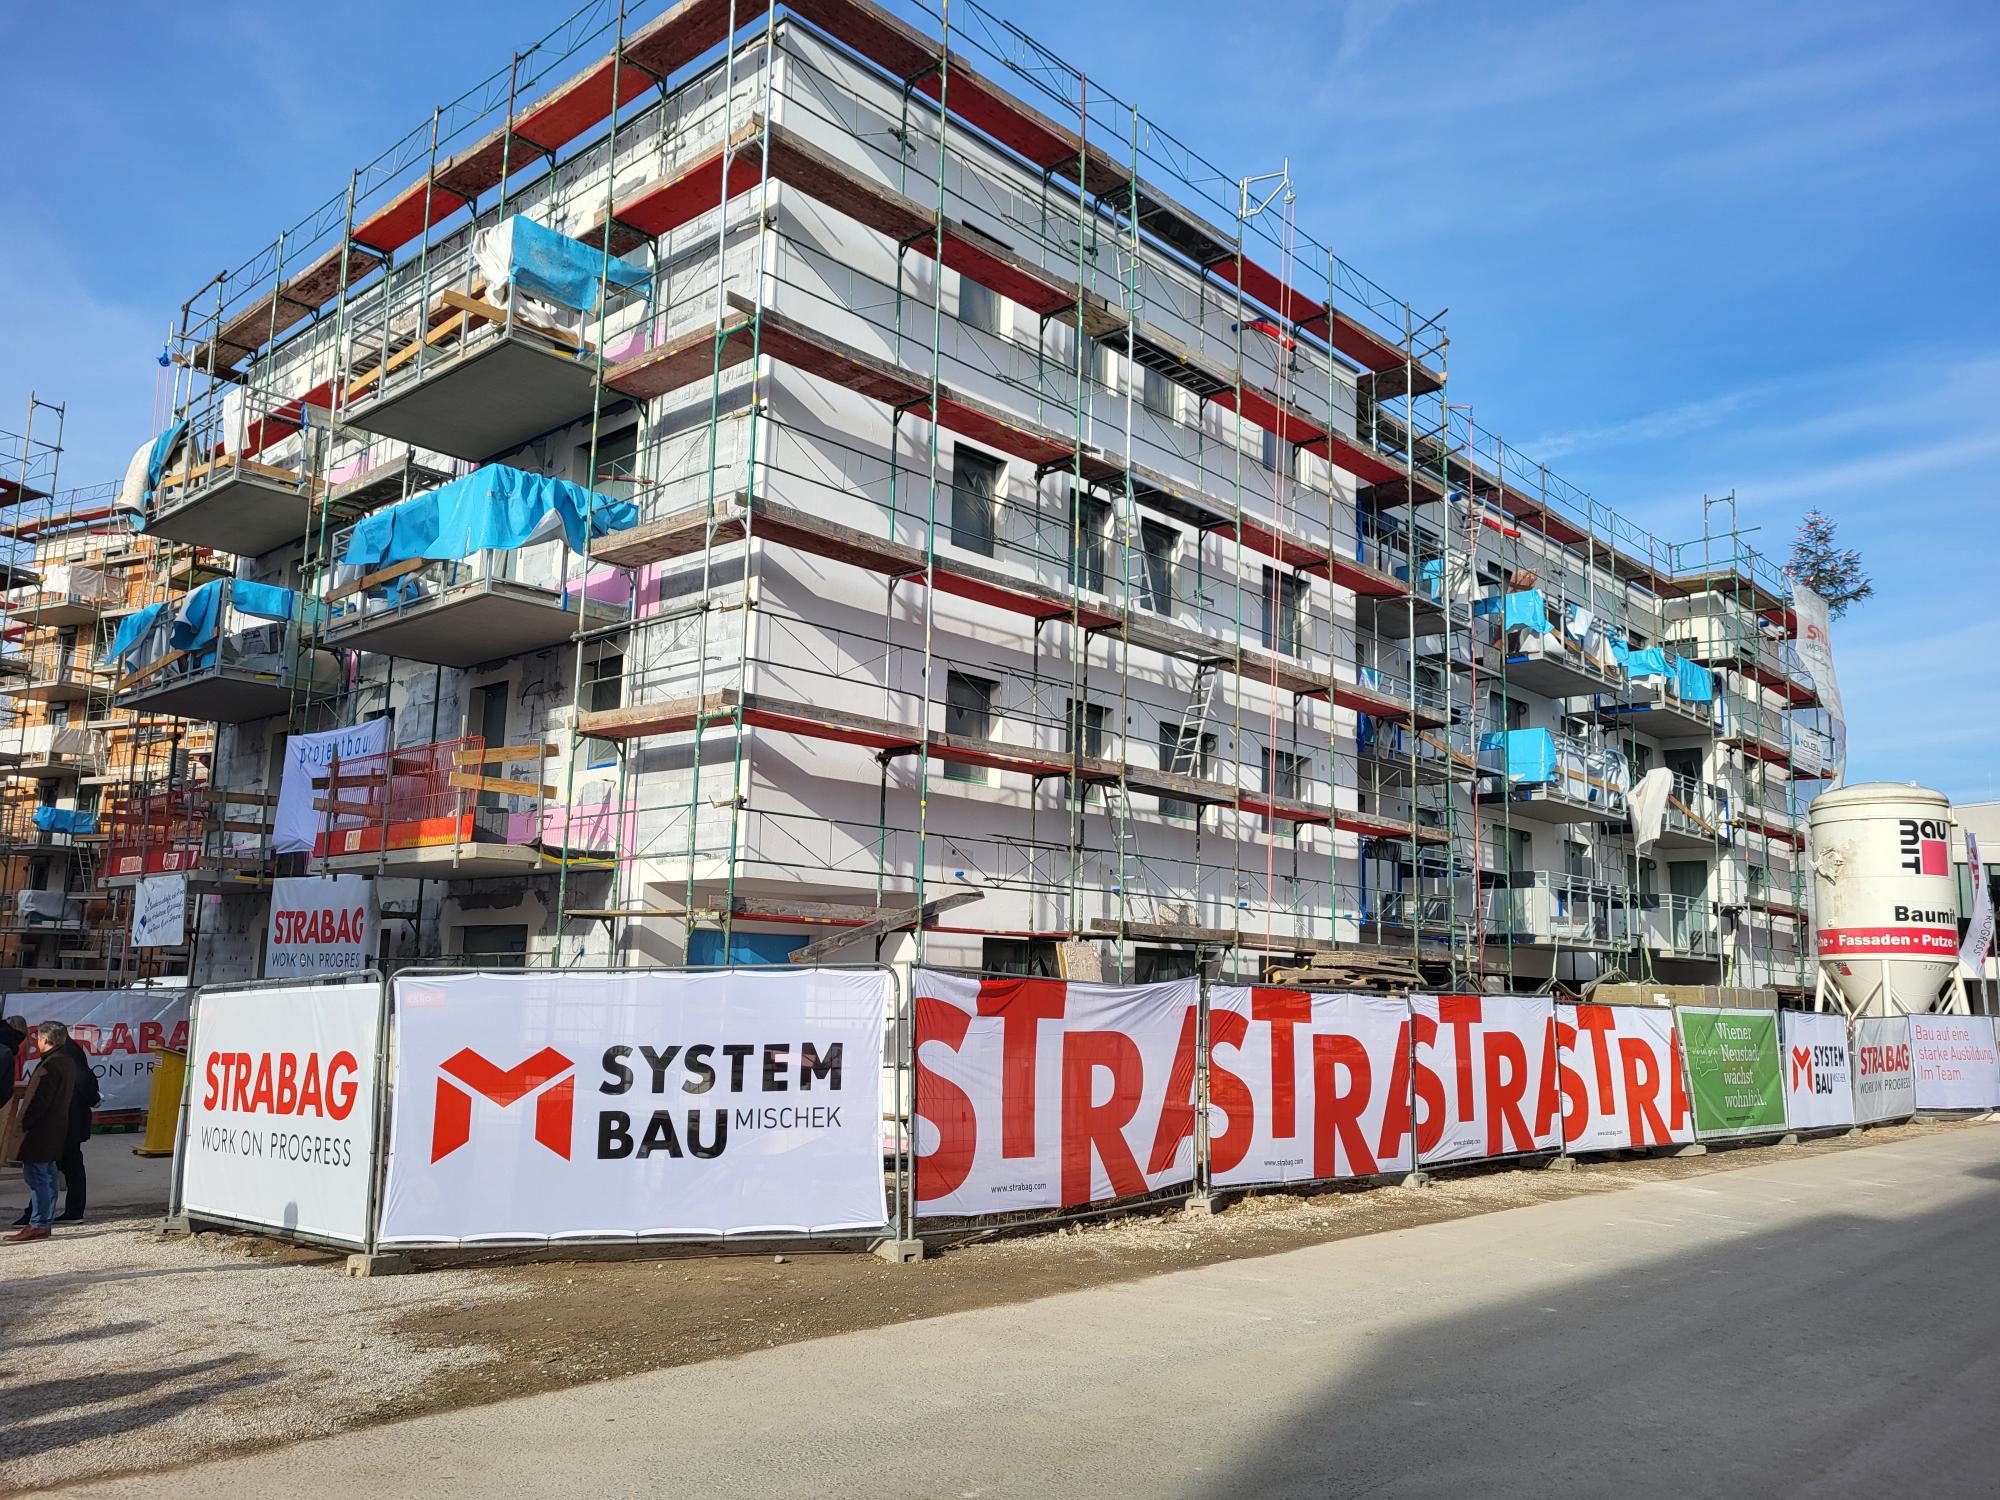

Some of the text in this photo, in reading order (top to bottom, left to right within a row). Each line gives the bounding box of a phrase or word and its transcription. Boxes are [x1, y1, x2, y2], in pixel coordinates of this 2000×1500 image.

[273, 906, 364, 945] STRABAG
[1838, 934, 1911, 946] Fassaden
[1922, 934, 1953, 948] Putze
[271, 952, 298, 967] WORK
[300, 952, 314, 967] ON
[1715, 1022, 1752, 1040] Wiener
[1915, 1024, 1969, 1041] Bau auf eine
[1814, 1045, 1845, 1068] SYSTEM
[1860, 1043, 1910, 1076] STRABAG
[1918, 1047, 1948, 1061] starke
[598, 1042, 844, 1096] SYSTEM
[1723, 1066, 1754, 1085] wächst
[1920, 1065, 1965, 1081] Im Team.
[203, 1050, 359, 1121] STRABAG
[1815, 1072, 1833, 1095] BAU
[597, 1106, 842, 1160] BAU MISCHEK
[201, 1126, 352, 1168] WORK ON PROGRESS
[990, 1182, 1047, 1194] www.strabag.com
